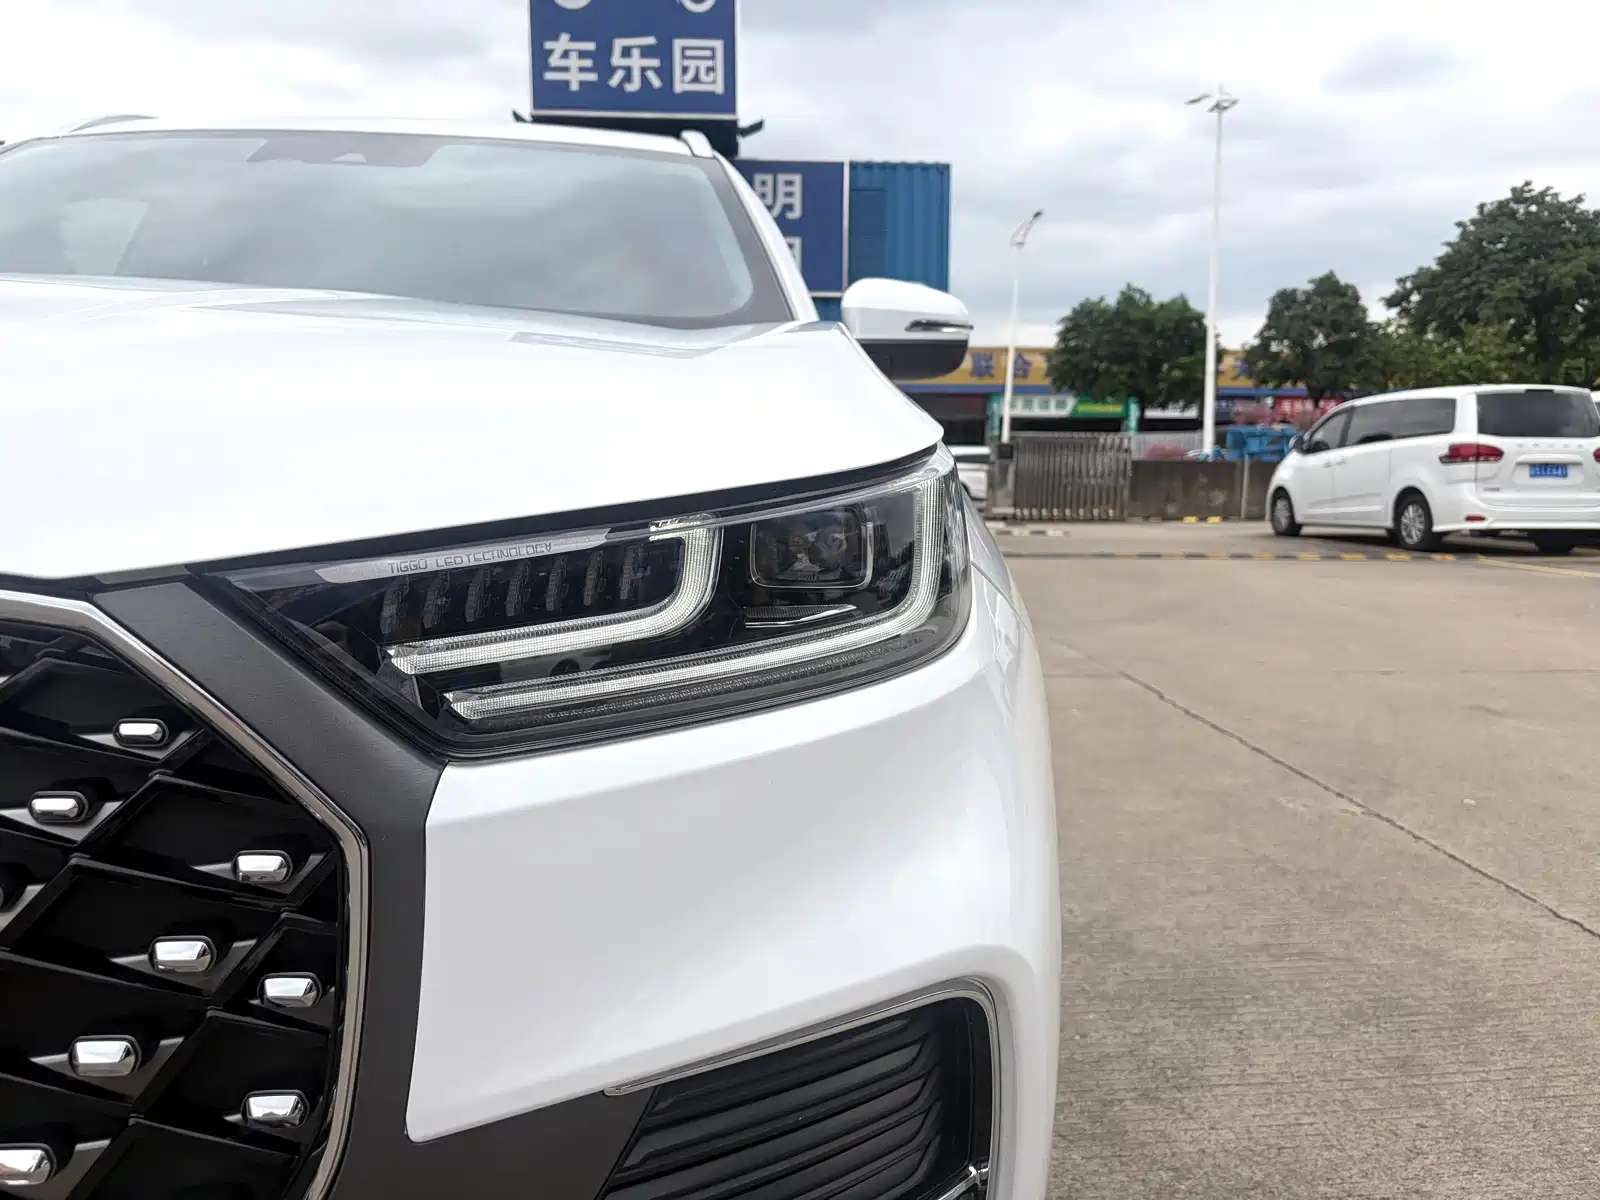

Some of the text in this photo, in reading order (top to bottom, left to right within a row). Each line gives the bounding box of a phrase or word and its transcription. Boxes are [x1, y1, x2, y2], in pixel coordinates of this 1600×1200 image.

[543, 32, 725, 94] 车乐园
[753, 173, 803, 219] 明
[970, 352, 1050, 379] 联合
[387, 541, 552, 574] TIGGO LED TECHNOLOGY
